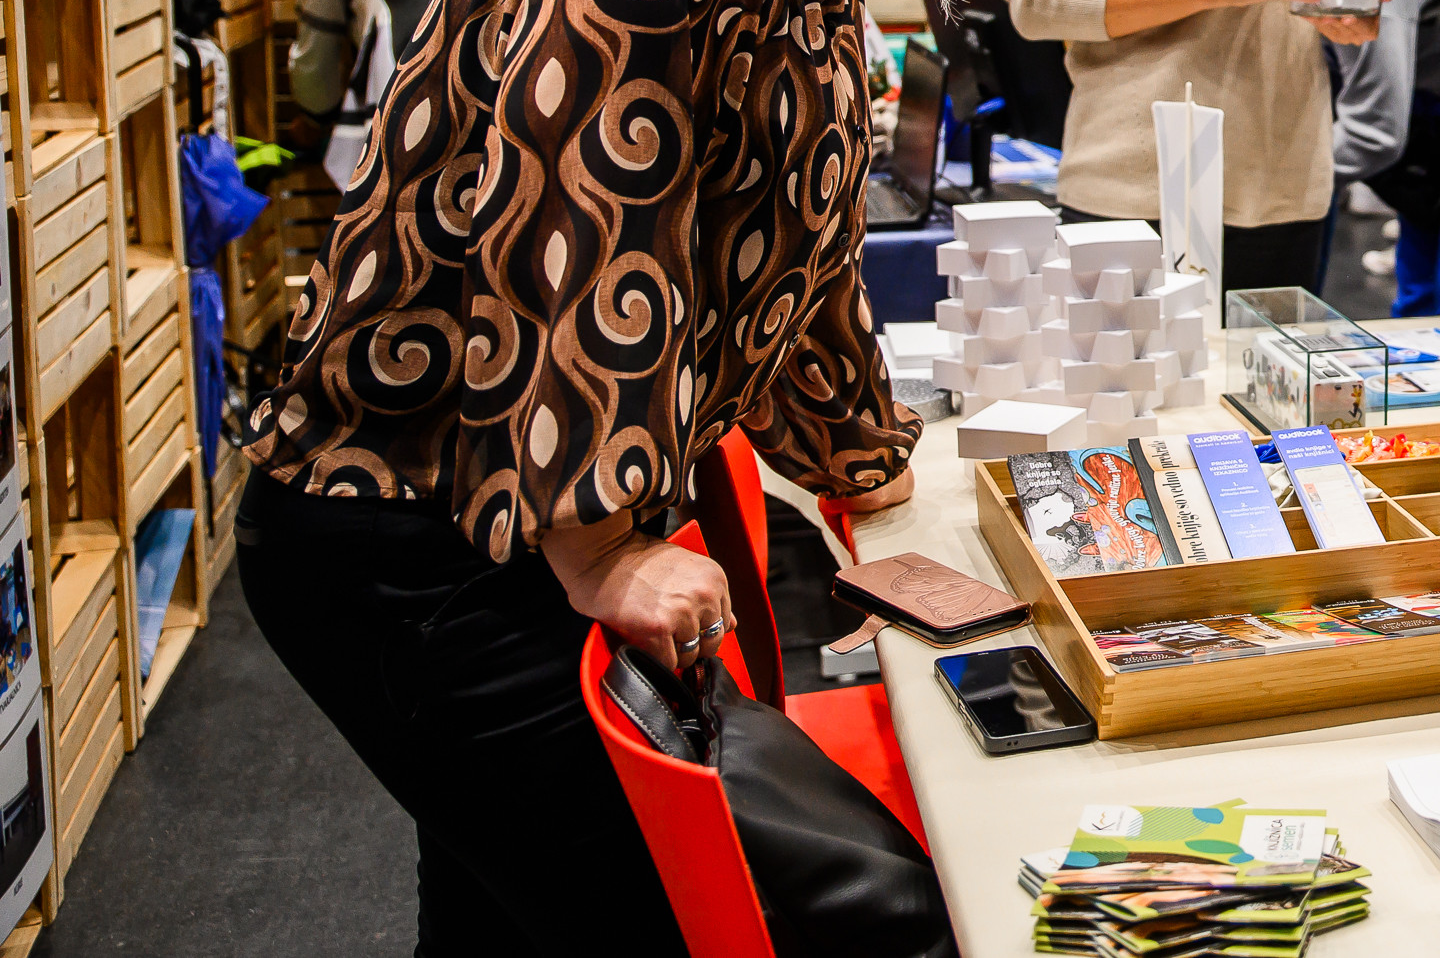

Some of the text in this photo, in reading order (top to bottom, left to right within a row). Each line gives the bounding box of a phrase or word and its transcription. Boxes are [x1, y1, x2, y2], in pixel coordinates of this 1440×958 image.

[1193, 433, 1241, 444] audibook
[1278, 428, 1325, 440] audibook
[1211, 459, 1238, 467] PRIJAVA
[1288, 452, 1304, 460] naši
[1026, 471, 1051, 480] knjige
[1213, 468, 1249, 476] IZKAZNICO
[1029, 478, 1064, 488] ogledala.
[1162, 471, 1185, 498] vedno
[1107, 498, 1132, 527] govorijo
[1174, 499, 1190, 511] so
[1176, 510, 1203, 541] knjige
[1126, 526, 1146, 549] knjige
[1131, 549, 1147, 570] Dobre
[1187, 541, 1209, 563] obre
[1263, 818, 1284, 851] KNJIŽNICA
[1281, 825, 1297, 851] semen
